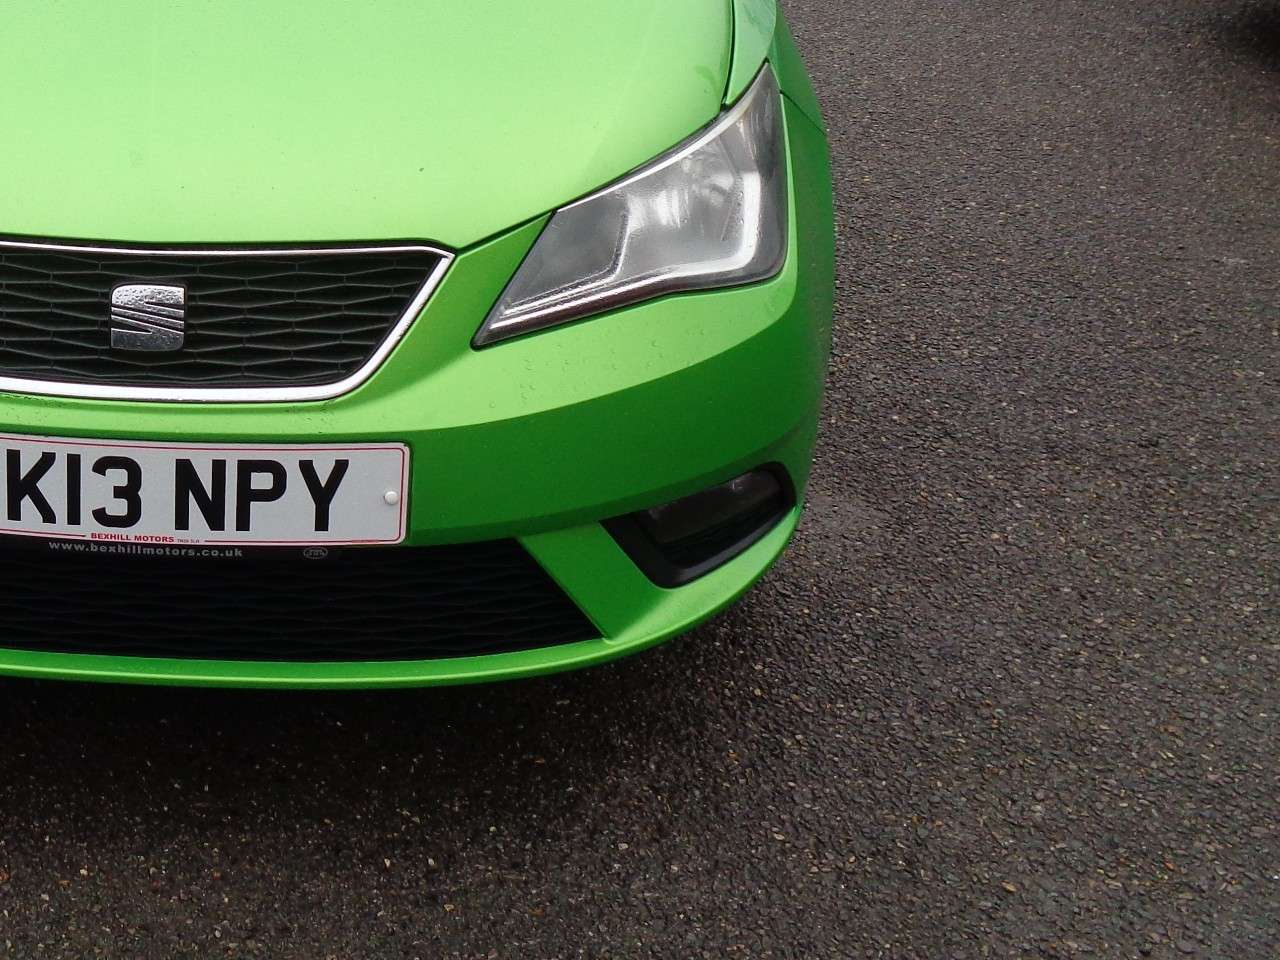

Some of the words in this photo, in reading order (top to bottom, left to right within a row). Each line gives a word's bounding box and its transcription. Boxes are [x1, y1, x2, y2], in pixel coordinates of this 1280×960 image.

[174, 459, 349, 532] NPY
[91, 532, 131, 540] BEXHILL
[134, 535, 174, 543] MOTORS
[49, 541, 243, 557] www.bexhillmotors.co.uk
